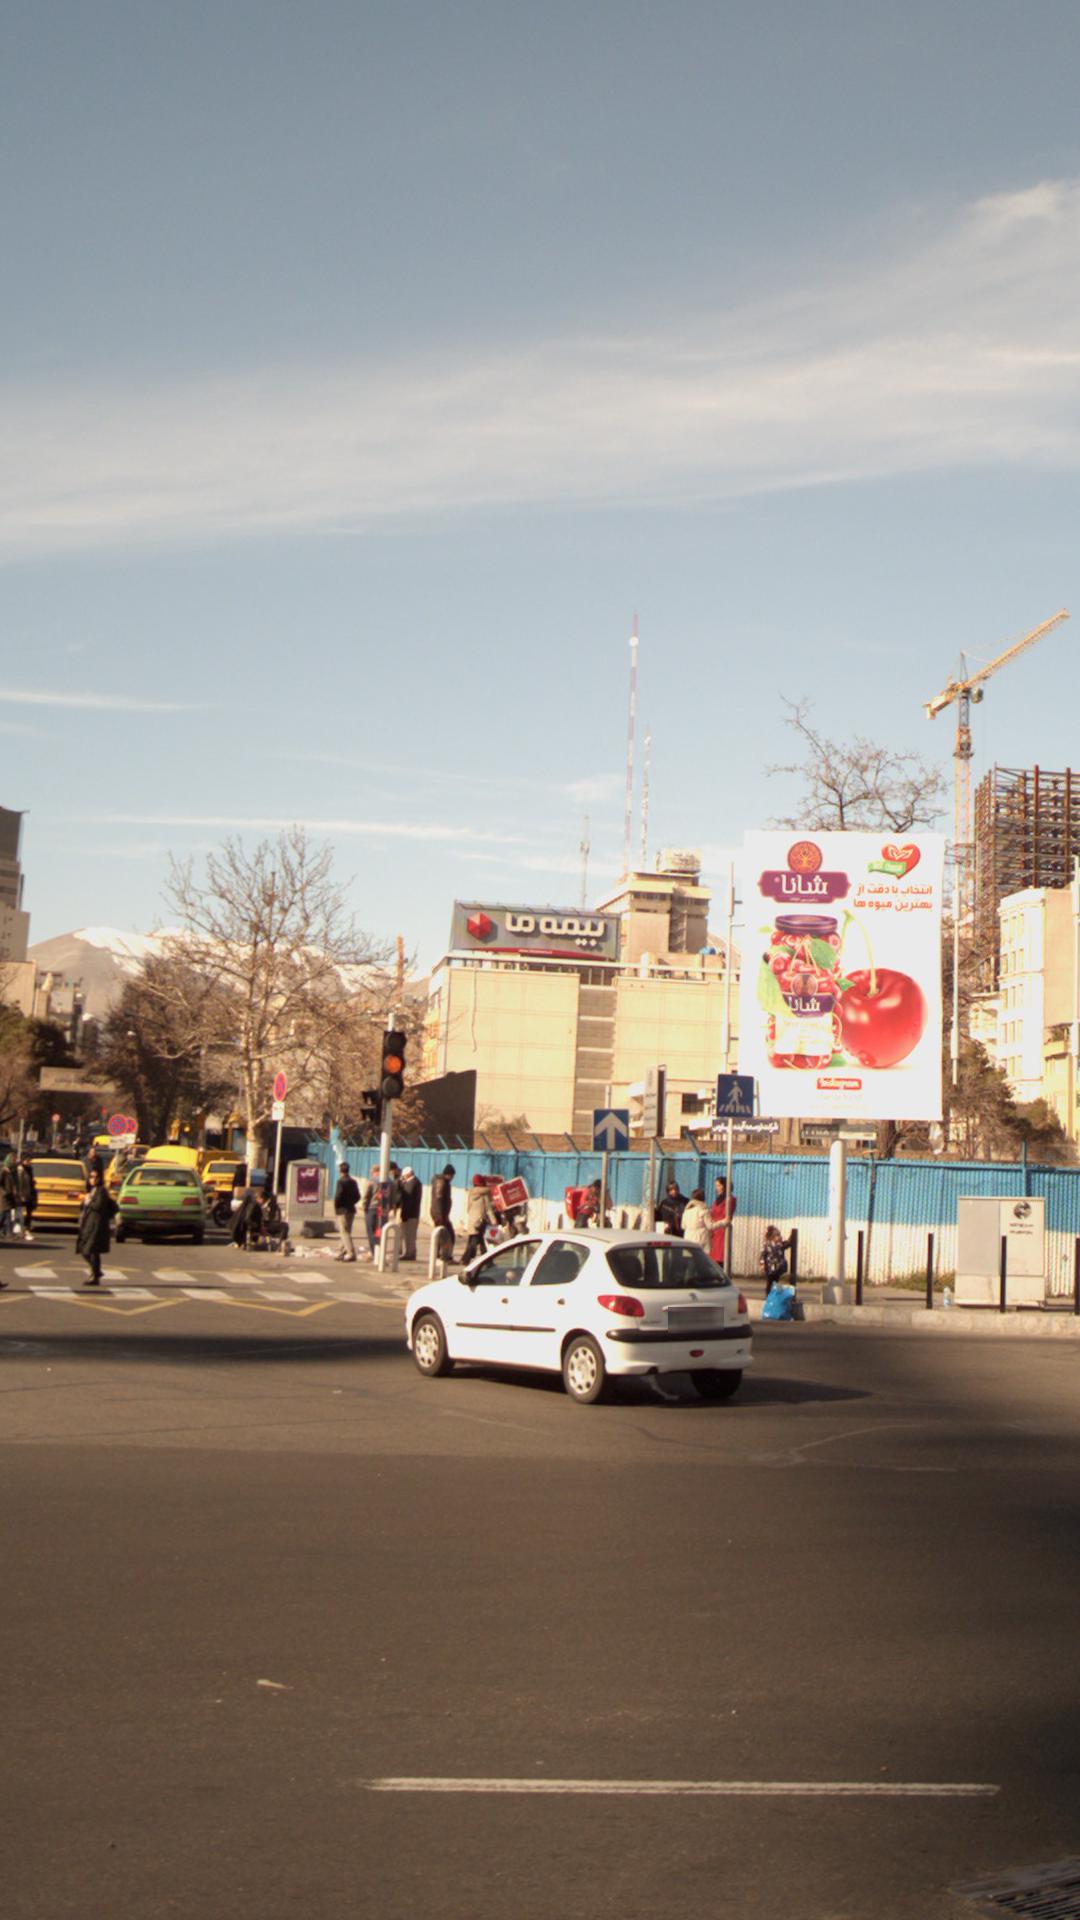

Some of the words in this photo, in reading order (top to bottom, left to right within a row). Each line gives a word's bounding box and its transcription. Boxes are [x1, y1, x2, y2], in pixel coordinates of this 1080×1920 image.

[781, 873, 828, 895] شانا
[867, 882, 889, 894] دقت
[901, 883, 932, 897] انتخاب
[853, 899, 866, 908] ها
[868, 900, 892, 912] میوه
[895, 899, 933, 912] بهترین
[505, 912, 535, 933] ما
[539, 916, 605, 947] بیمه
[788, 996, 820, 1012] شانا
